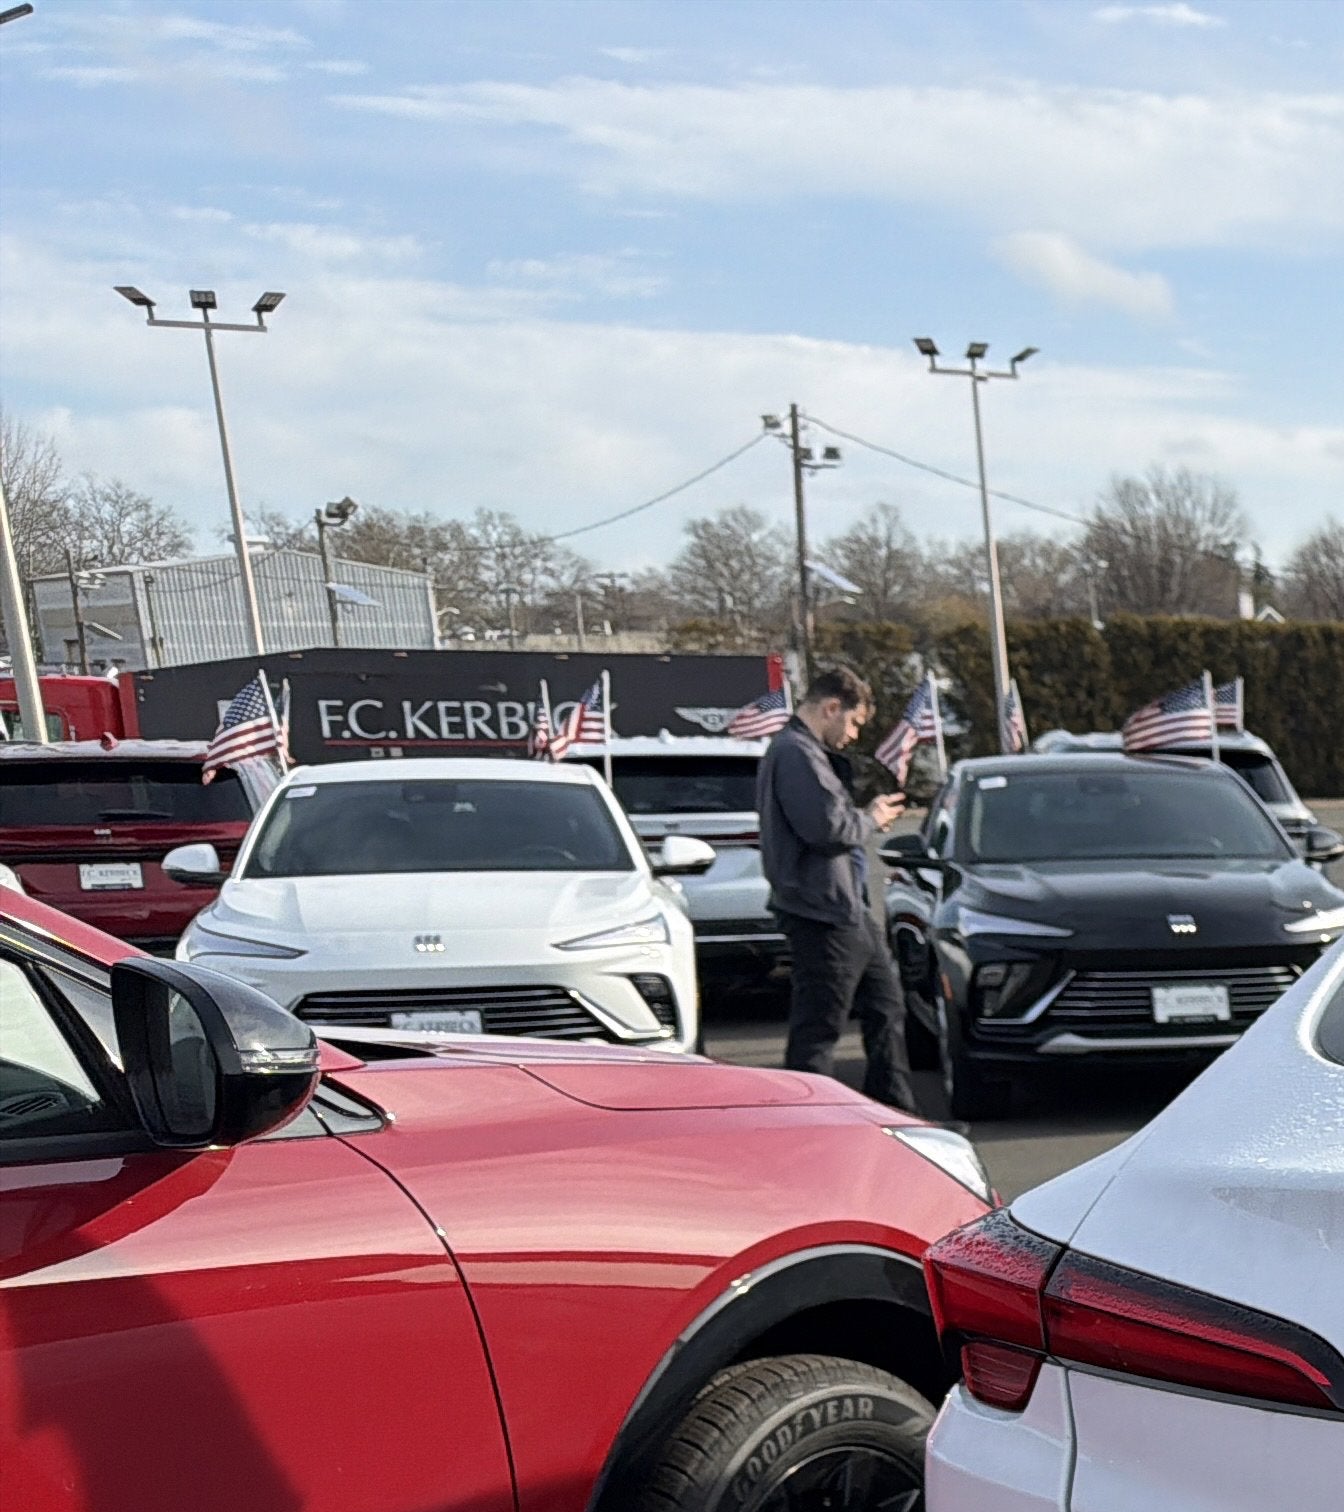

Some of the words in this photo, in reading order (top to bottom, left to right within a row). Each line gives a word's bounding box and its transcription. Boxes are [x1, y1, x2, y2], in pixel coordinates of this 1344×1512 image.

[318, 699, 397, 739] F.C.
[402, 700, 618, 740] KERBC
[733, 1397, 875, 1502] GOODYEAR
